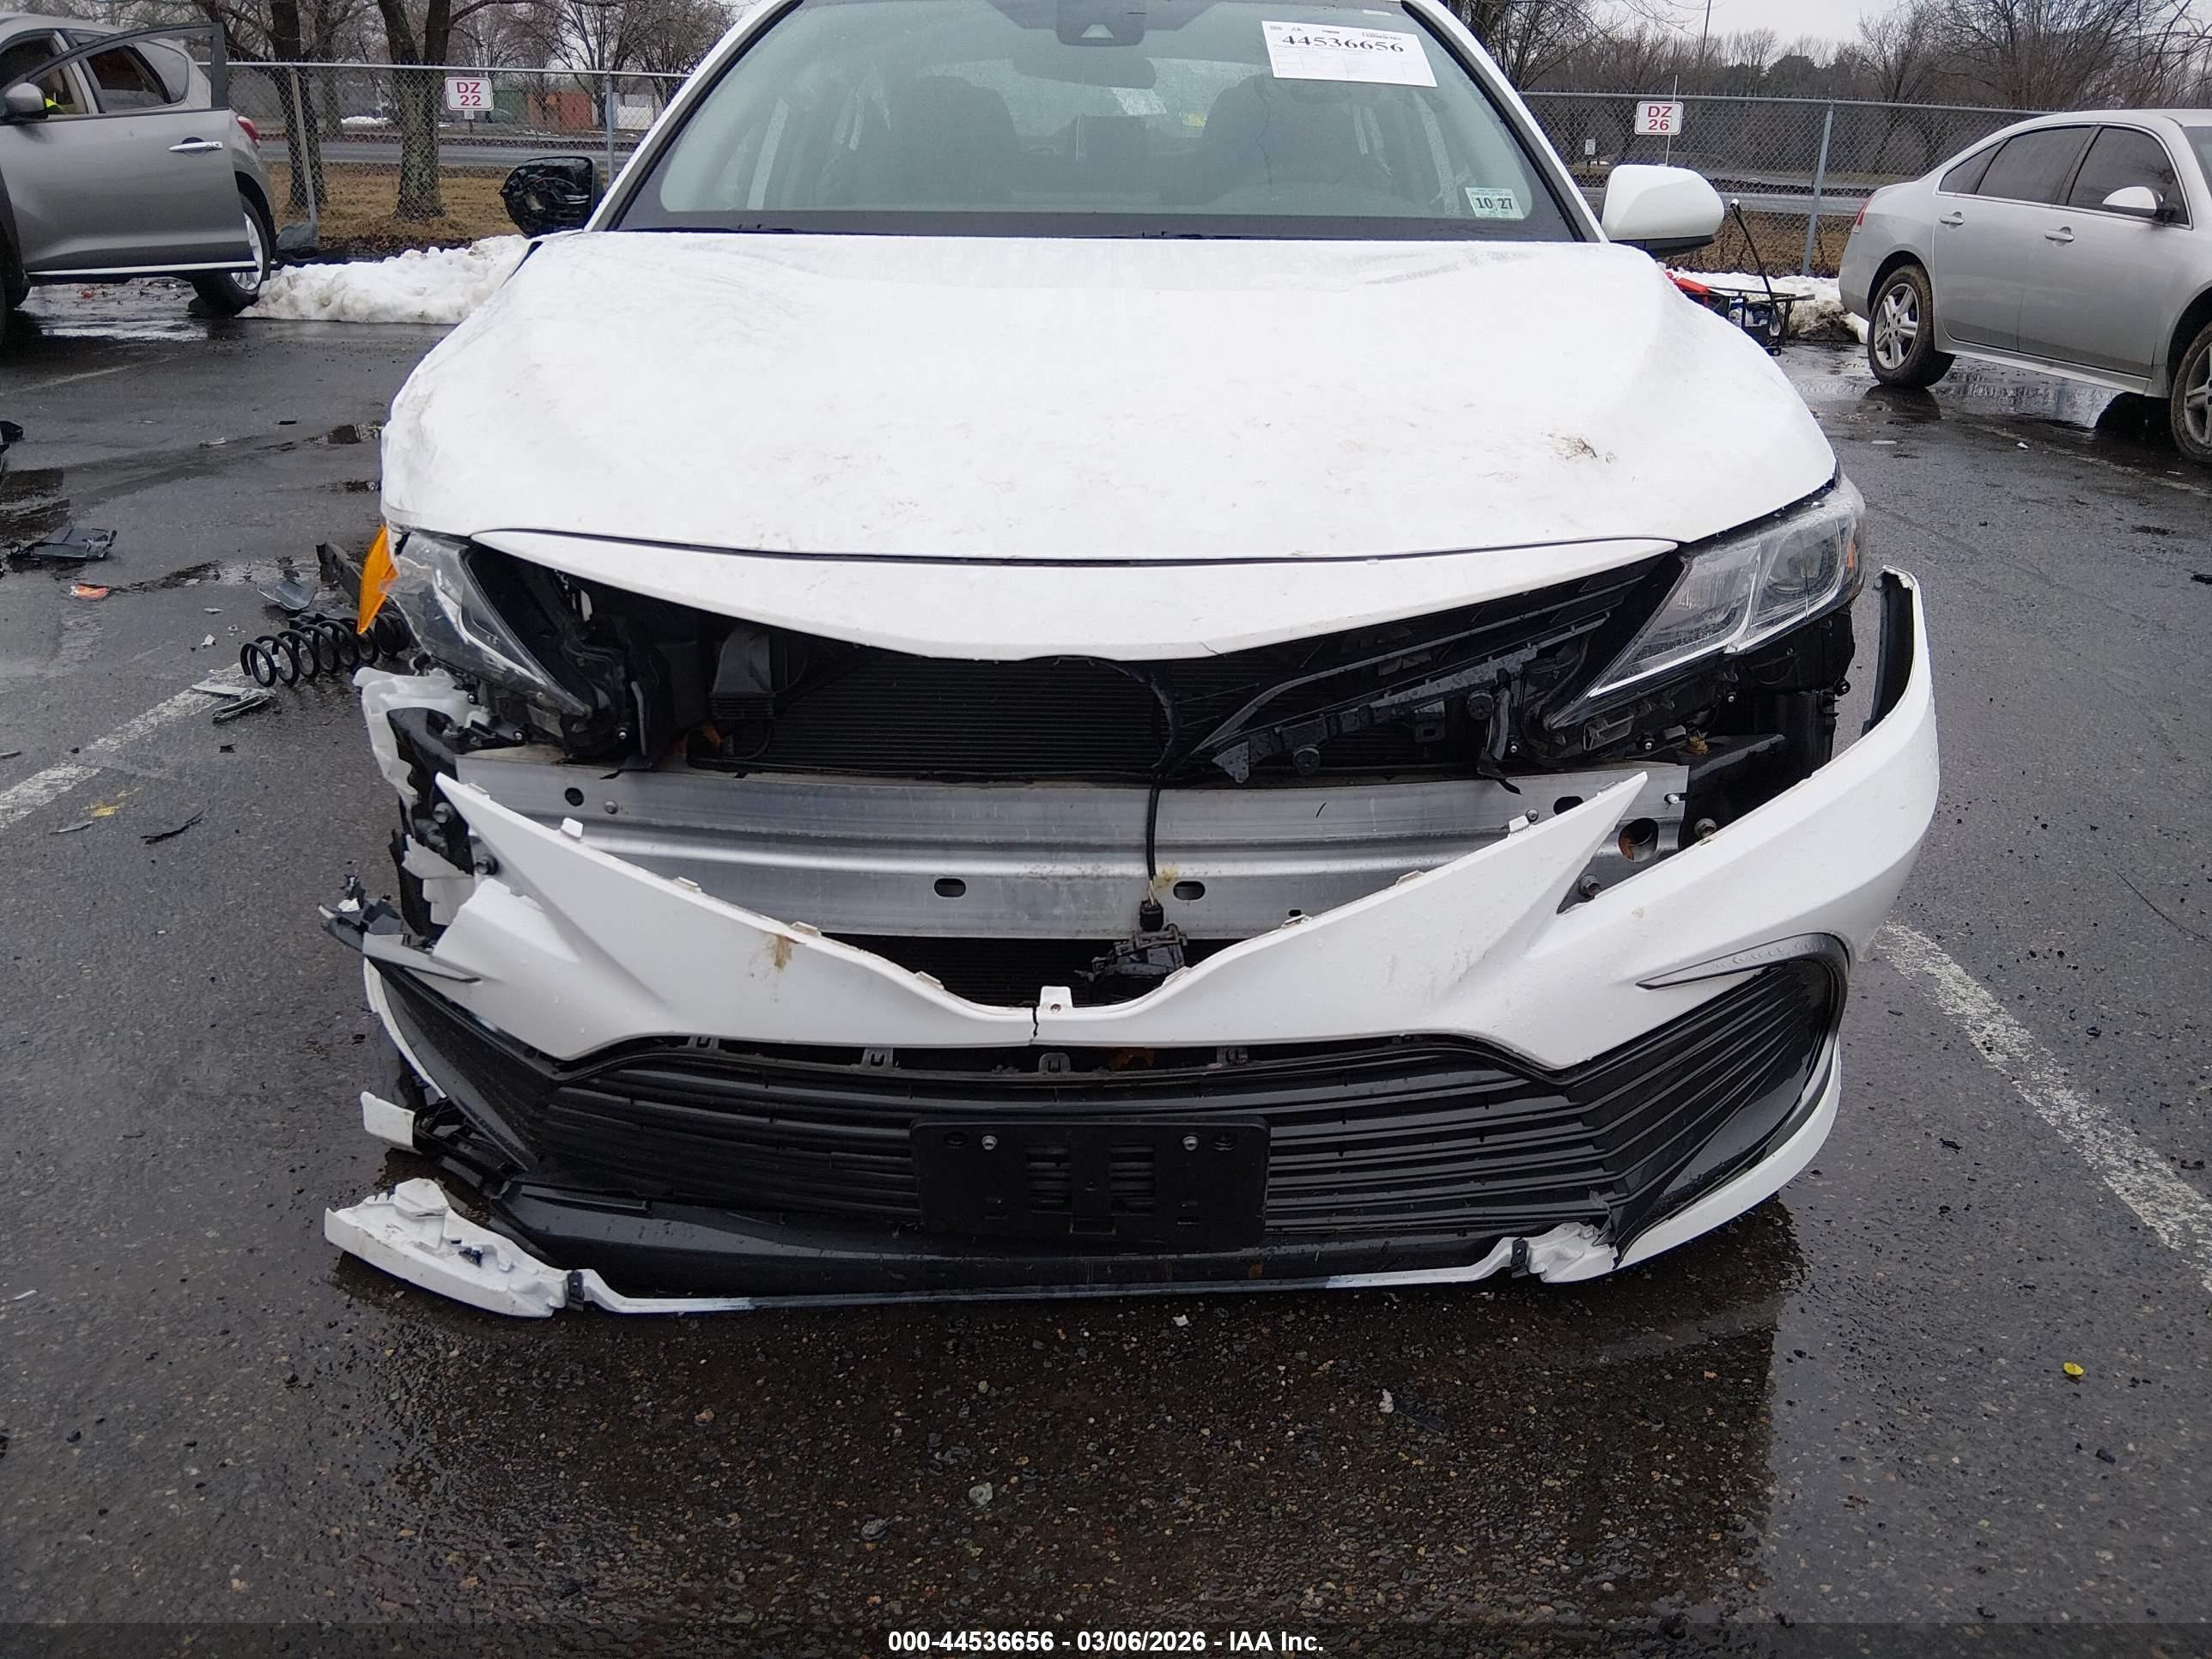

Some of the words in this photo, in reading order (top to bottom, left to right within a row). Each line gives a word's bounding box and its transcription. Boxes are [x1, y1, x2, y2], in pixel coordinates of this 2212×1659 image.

[1282, 35, 1404, 52] 44536656
[456, 82, 482, 94] DZ
[459, 95, 482, 106] 22
[1647, 106, 1673, 118] DZ
[1648, 118, 1669, 131] 26
[1475, 197, 1493, 209] 10
[1497, 197, 1513, 210] 27
